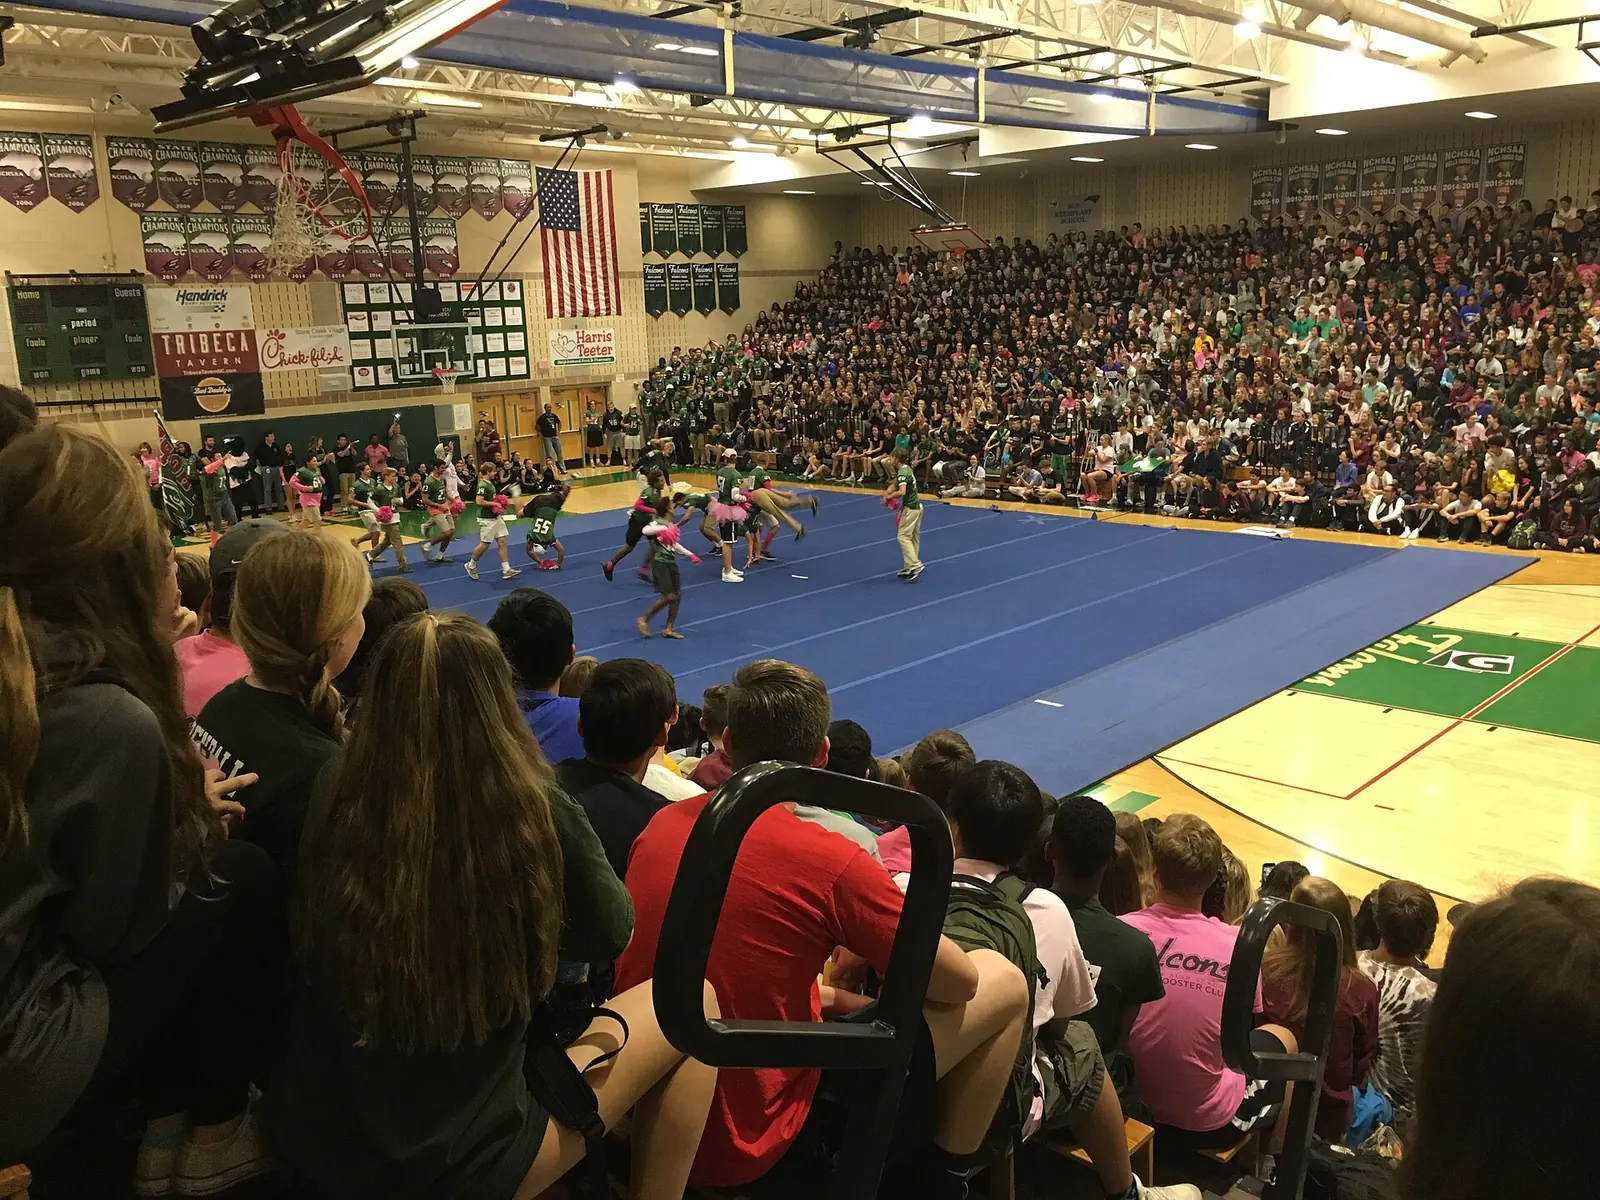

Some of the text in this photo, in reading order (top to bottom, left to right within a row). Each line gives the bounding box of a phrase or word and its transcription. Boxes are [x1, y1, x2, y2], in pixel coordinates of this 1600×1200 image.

[0, 142, 42, 156] HAMPIONS
[45, 144, 93, 158] CHAMPIONS
[108, 147, 152, 160] CHAMPIONS
[1445, 149, 1480, 161] NCHSAA
[1487, 145, 1524, 157] NCHSAA
[156, 150, 199, 163] CHAMPIONS
[202, 152, 242, 165] CHAMPIONS
[1363, 156, 1396, 168] NCHSAA
[1403, 152, 1438, 165] NCHSAA
[364, 161, 399, 174] CHAMPIONS
[435, 165, 467, 176] CHAMPIONS
[469, 165, 500, 177] CHAMPIONS
[1288, 163, 1319, 176] NCHSAA
[1325, 160, 1357, 170] NCHSAA
[501, 167, 530, 179] CHAMPIONS
[1253, 167, 1282, 180] NCHSAA
[1454, 174, 1468, 182] 4-A
[1442, 181, 1479, 191] 2014-2015
[1484, 178, 1524, 188] 2015-2016
[1323, 191, 1357, 200] 2011-2012
[1362, 188, 1396, 197] 2012-2013
[1401, 185, 1436, 194] 2013-2014
[1286, 194, 1318, 203] 2010-2011
[652, 204, 674, 214] Falcons
[677, 204, 698, 214] Falcons
[141, 221, 186, 234] CHAMPIONS
[187, 222, 229, 235] CHAMPIONS
[231, 222, 272, 235] CHAMPIONS
[423, 226, 456, 238] CHAMPIONS
[643, 264, 665, 273] Falcons
[669, 264, 689, 273] Falcons
[693, 264, 714, 273] Falcons
[717, 263, 737, 273] Falcons
[17, 290, 40, 300] Home
[114, 287, 141, 298] Guests
[176, 289, 228, 306] Hendrick
[71, 318, 97, 330] period
[26, 337, 46, 347] fouls
[73, 335, 98, 346] player
[125, 334, 143, 343] fouls
[576, 330, 613, 344] Harris
[161, 331, 250, 356] TRIBECA
[261, 337, 344, 369] Chick-fil-A
[576, 344, 613, 357] Teeter
[176, 357, 242, 368] TAVERN
[33, 371, 50, 379] won
[80, 367, 101, 378] game
[131, 365, 146, 373] won
[533, 518, 552, 535] 55
[1161, 977, 1224, 998] OOSTER CLU
